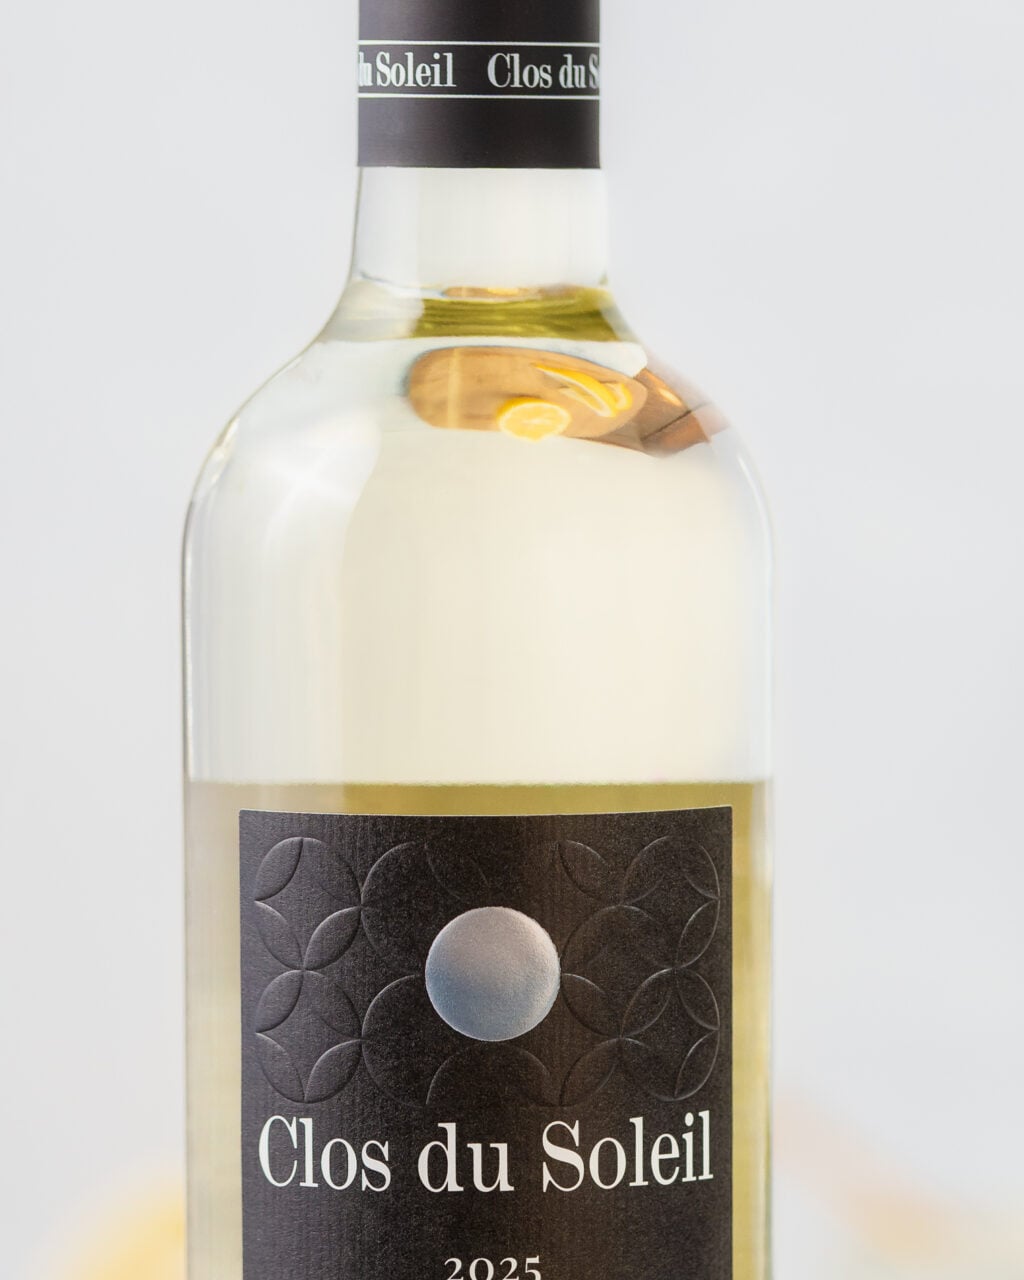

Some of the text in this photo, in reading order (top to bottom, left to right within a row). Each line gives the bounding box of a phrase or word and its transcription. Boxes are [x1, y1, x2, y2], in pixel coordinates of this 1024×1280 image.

[375, 50, 457, 88] Soleil
[487, 52, 553, 89] Clos
[558, 53, 587, 89] du
[258, 1109, 714, 1193] Clos du Soleil
